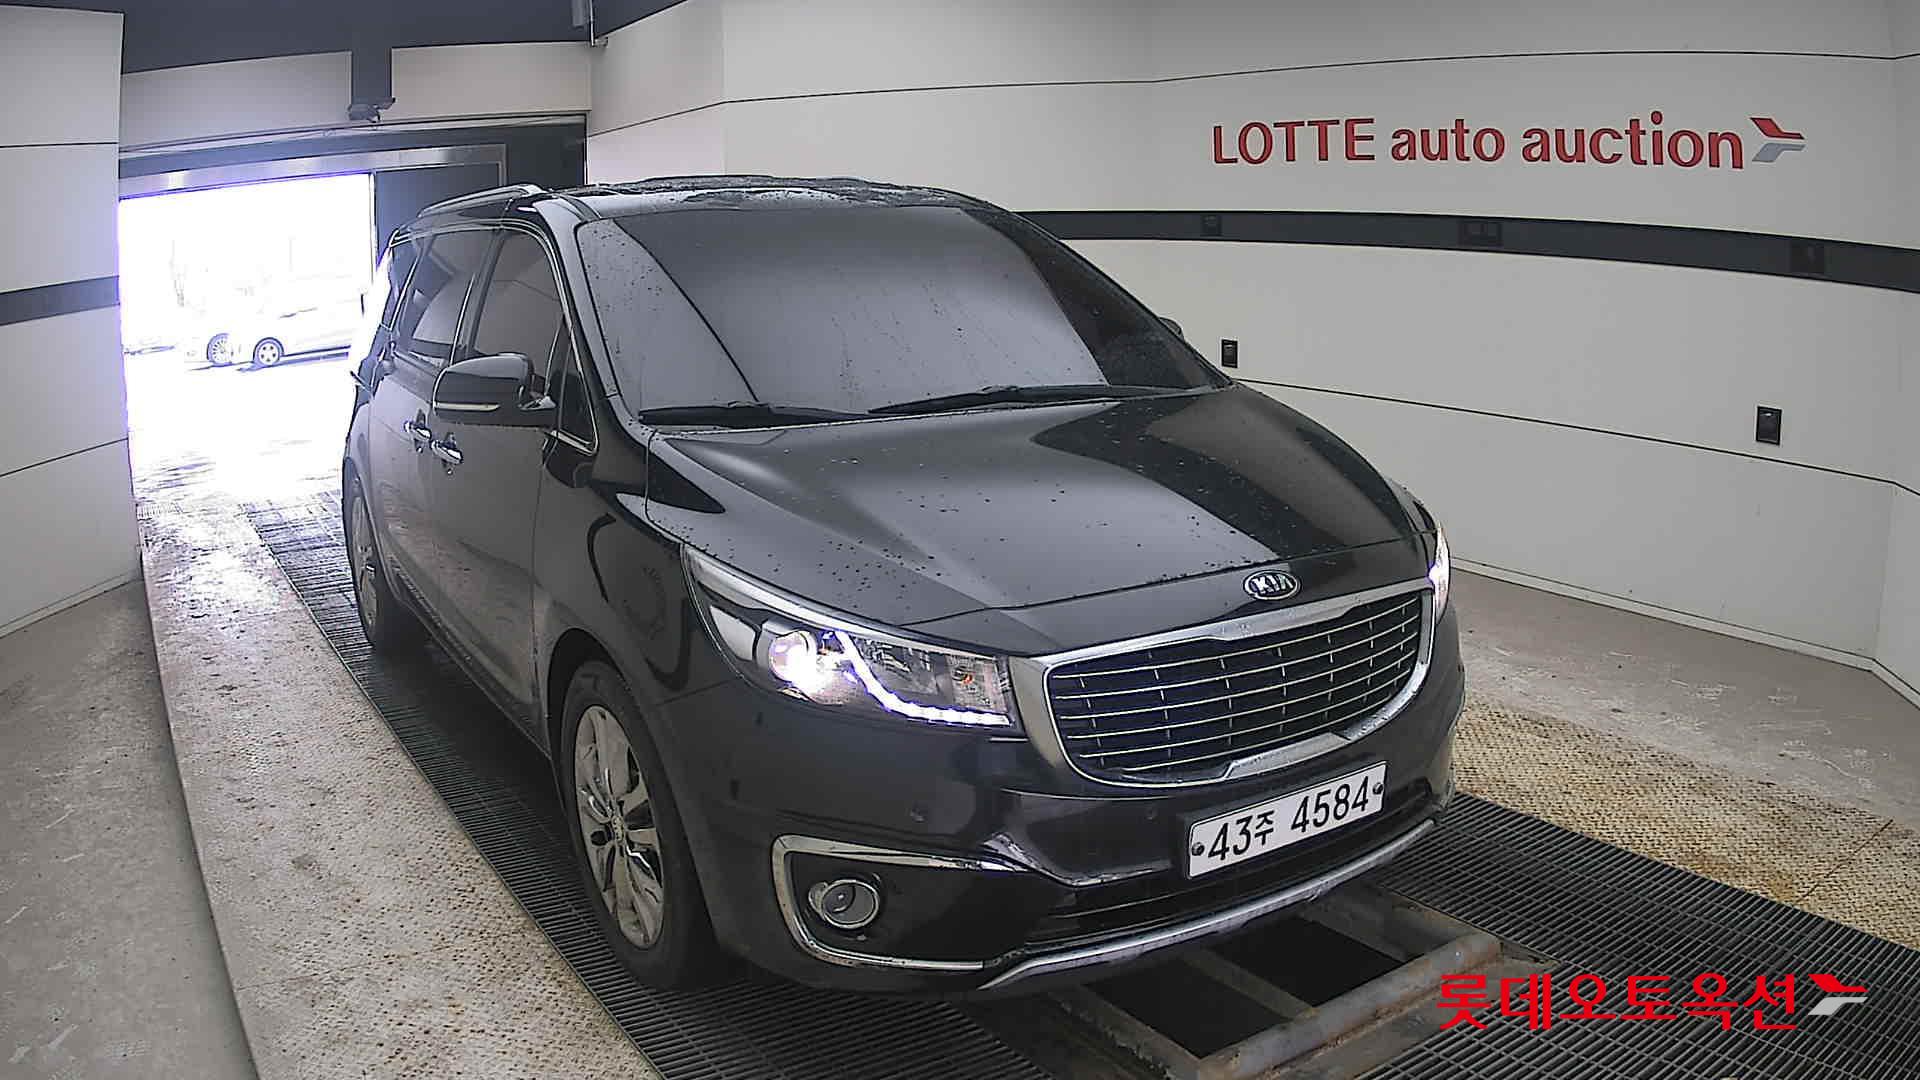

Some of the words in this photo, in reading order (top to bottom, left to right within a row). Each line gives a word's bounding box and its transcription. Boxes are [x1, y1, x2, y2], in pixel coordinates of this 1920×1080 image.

[1213, 117, 1376, 165] LOTTE
[1391, 118, 1506, 163] auto
[1522, 110, 1745, 170] auction
[1250, 574, 1294, 596] KIA
[1207, 810, 1275, 861] 43주
[1291, 776, 1370, 833] 4584
